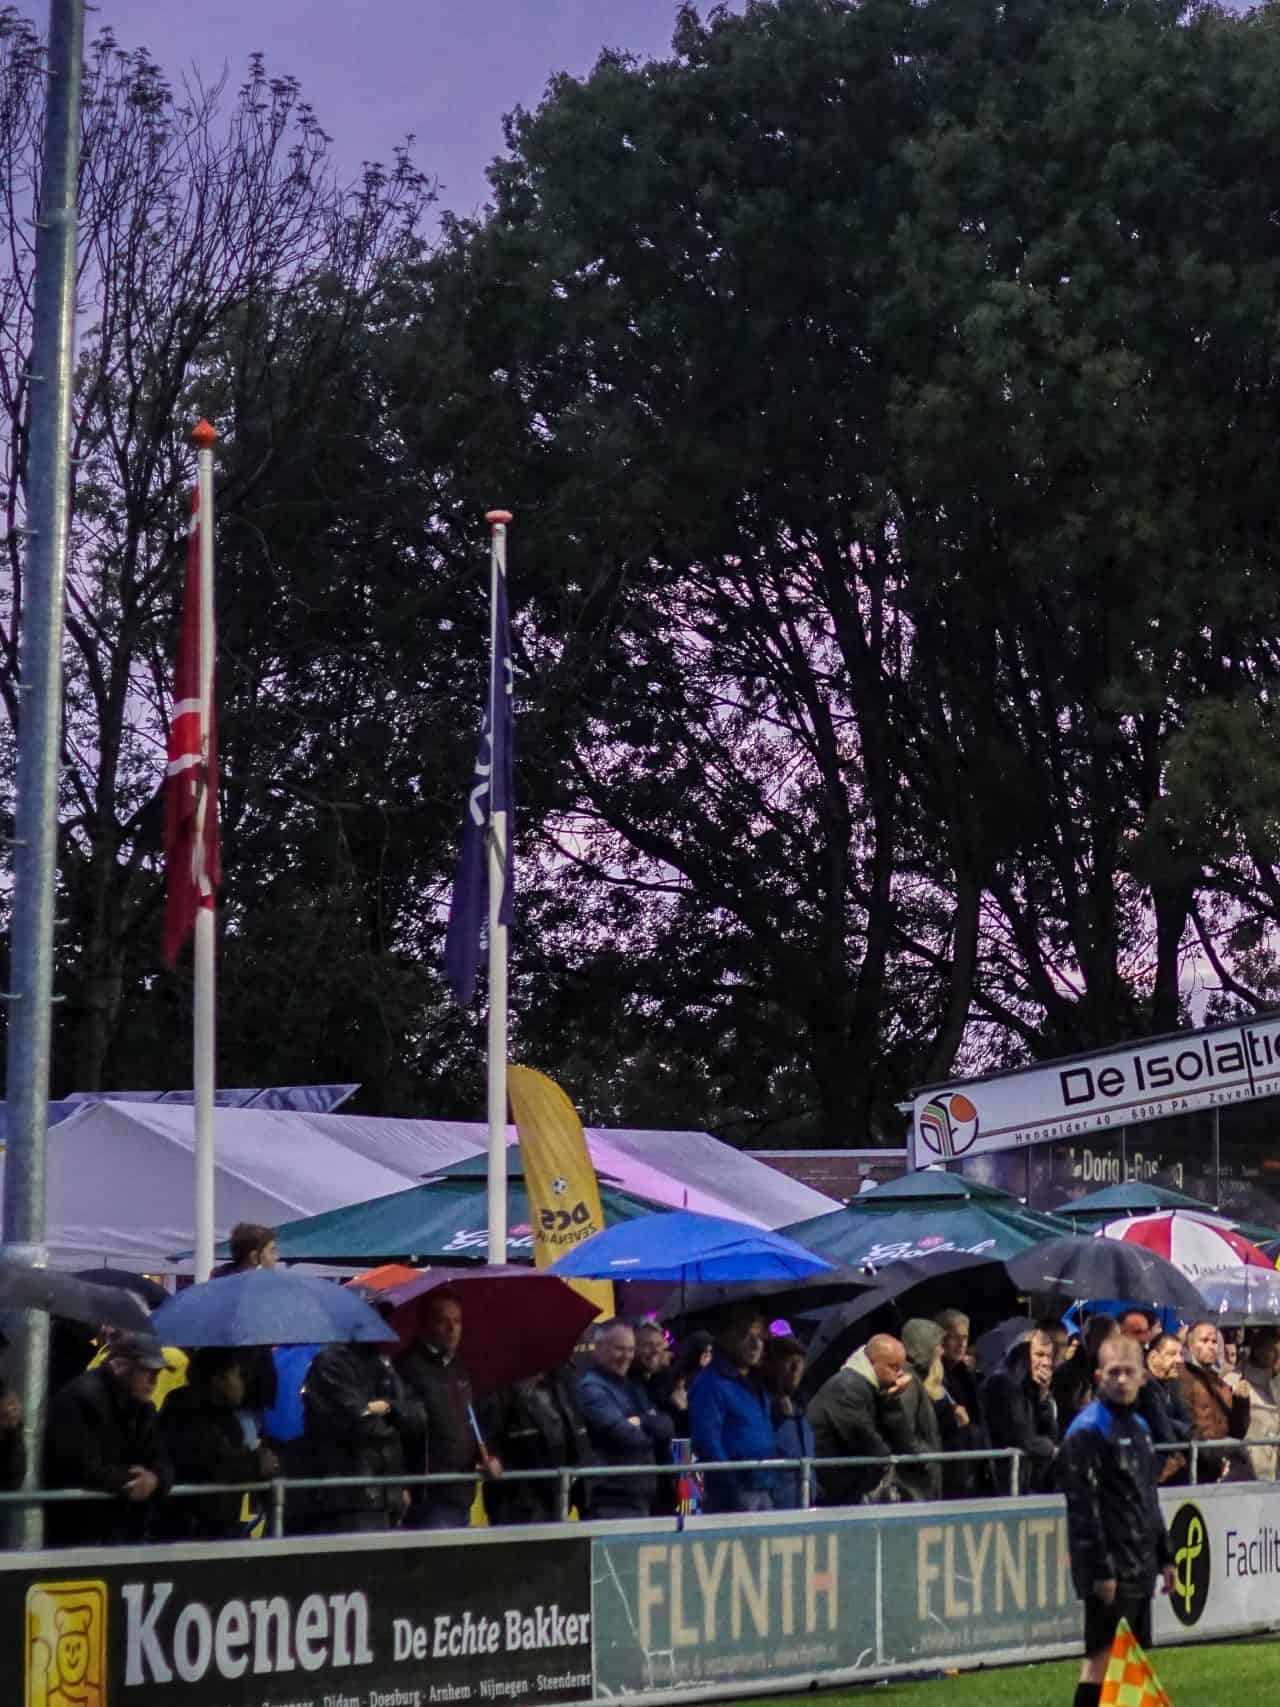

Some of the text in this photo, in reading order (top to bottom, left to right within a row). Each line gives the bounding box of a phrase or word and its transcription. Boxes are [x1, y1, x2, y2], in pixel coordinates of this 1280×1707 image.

[1015, 1121, 1089, 1143] Hengelder
[1096, 1114, 1112, 1127] 40
[1130, 1104, 1165, 1121] 6902
[1171, 1099, 1188, 1111] PA
[638, 1534, 839, 1652] FLYNTH
[121, 1581, 591, 1687] Koenen De Echte Bakker
[369, 1687, 421, 1707] Doesburg
[429, 1683, 472, 1703] Arnhem
[479, 1678, 529, 1700] Nijmegen
